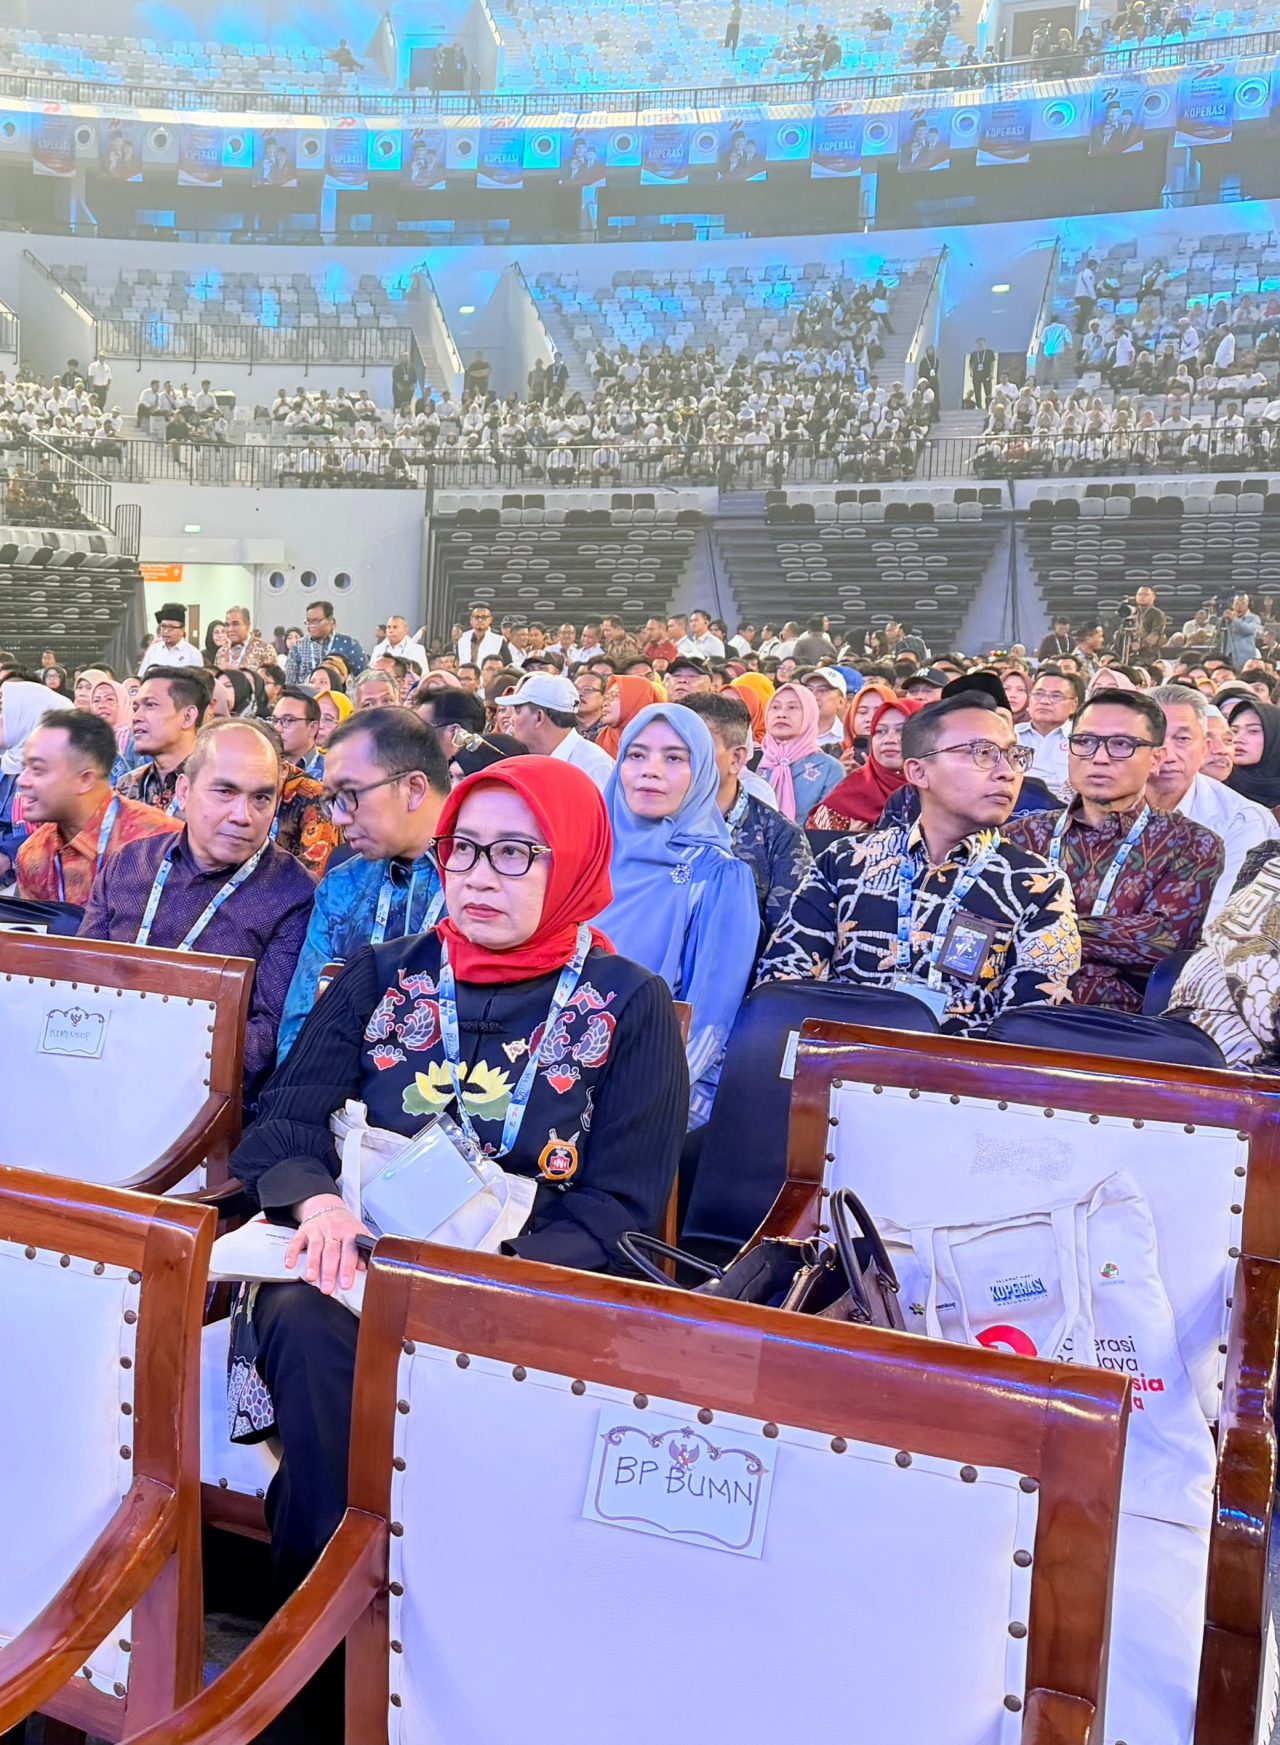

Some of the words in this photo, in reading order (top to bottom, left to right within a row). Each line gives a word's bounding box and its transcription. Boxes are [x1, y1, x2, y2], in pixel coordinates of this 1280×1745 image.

[1184, 104, 1226, 118] KOPERASI
[984, 126, 1025, 138] KOPERASI
[989, 1278, 1047, 1302] KOPERASI
[615, 1456, 659, 1485] BP
[665, 1466, 753, 1505] BUMN
